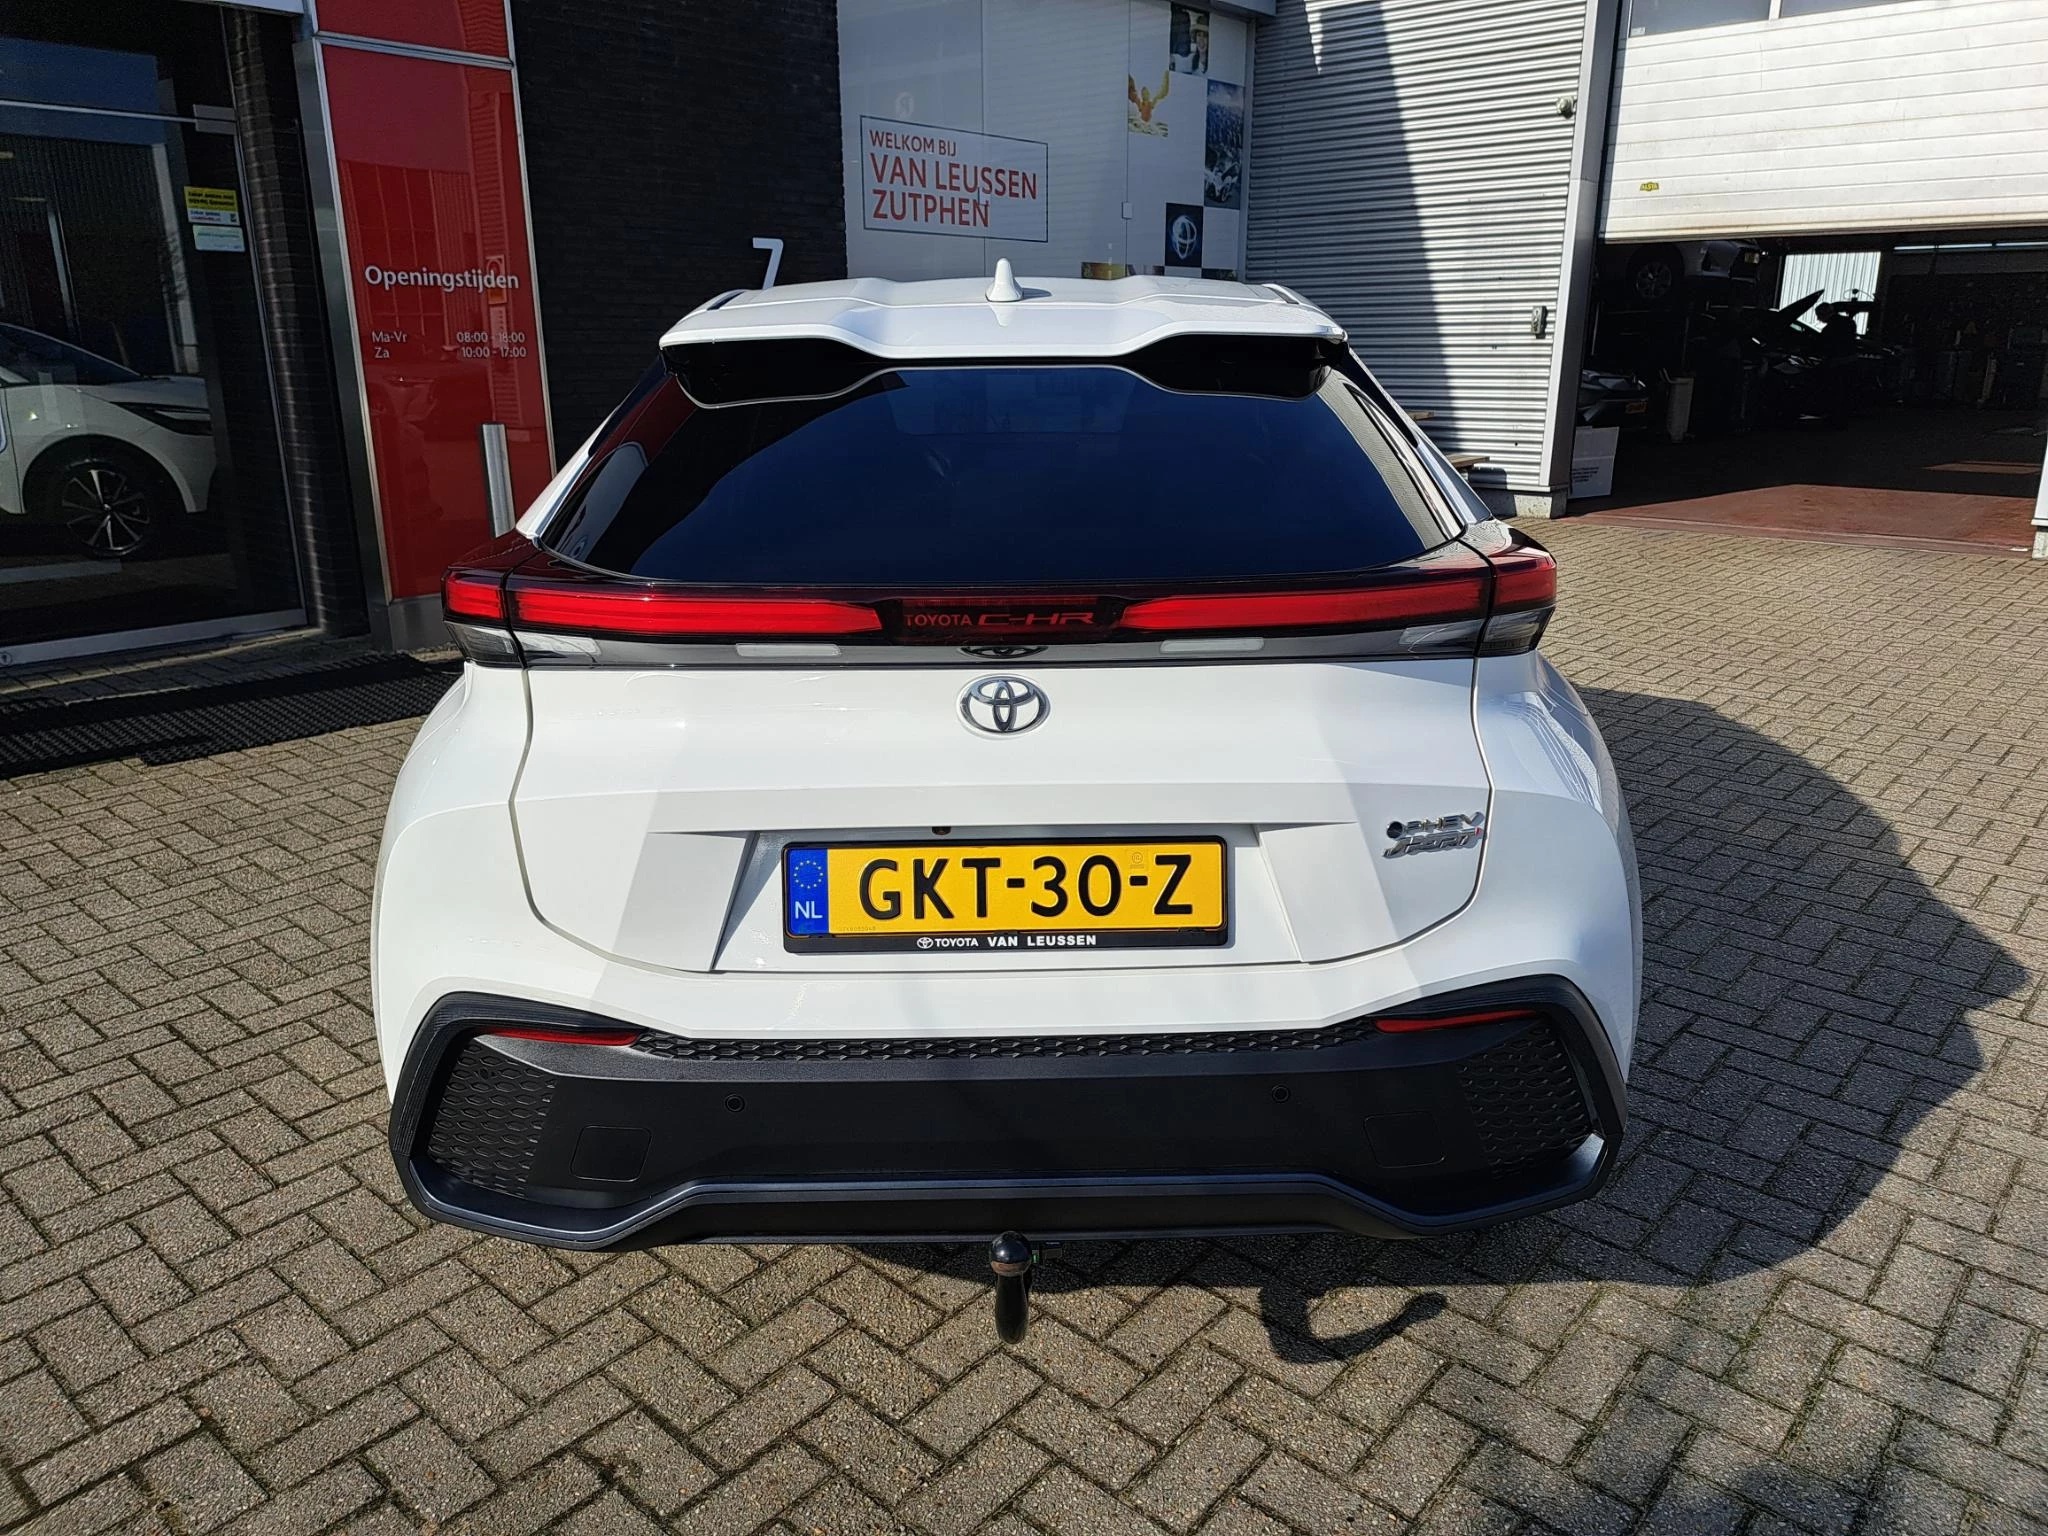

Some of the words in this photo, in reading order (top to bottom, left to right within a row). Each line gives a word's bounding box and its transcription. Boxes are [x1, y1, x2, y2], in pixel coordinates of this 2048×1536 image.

[869, 129, 935, 154] WELKOM
[938, 139, 957, 157] BIJ
[870, 152, 927, 188] VAN
[935, 160, 1038, 200] LEUSSEN
[872, 188, 991, 228] ZUTPHEN
[752, 237, 784, 290] 7
[364, 265, 520, 293] Openingstijden
[371, 331, 408, 344] Ma-Vr
[456, 331, 488, 344] 08:00
[374, 347, 391, 359] Za
[462, 346, 490, 358] 10:00
[501, 347, 527, 358] 17:00
[905, 614, 973, 627] TOYOTA
[977, 611, 1095, 626] C-HR
[859, 854, 1194, 921] GKT-30-Z
[794, 900, 824, 920] NL
[935, 937, 980, 948] TOYOTA
[987, 935, 1019, 948] VAN
[1026, 934, 1097, 947] LEUSSEN
